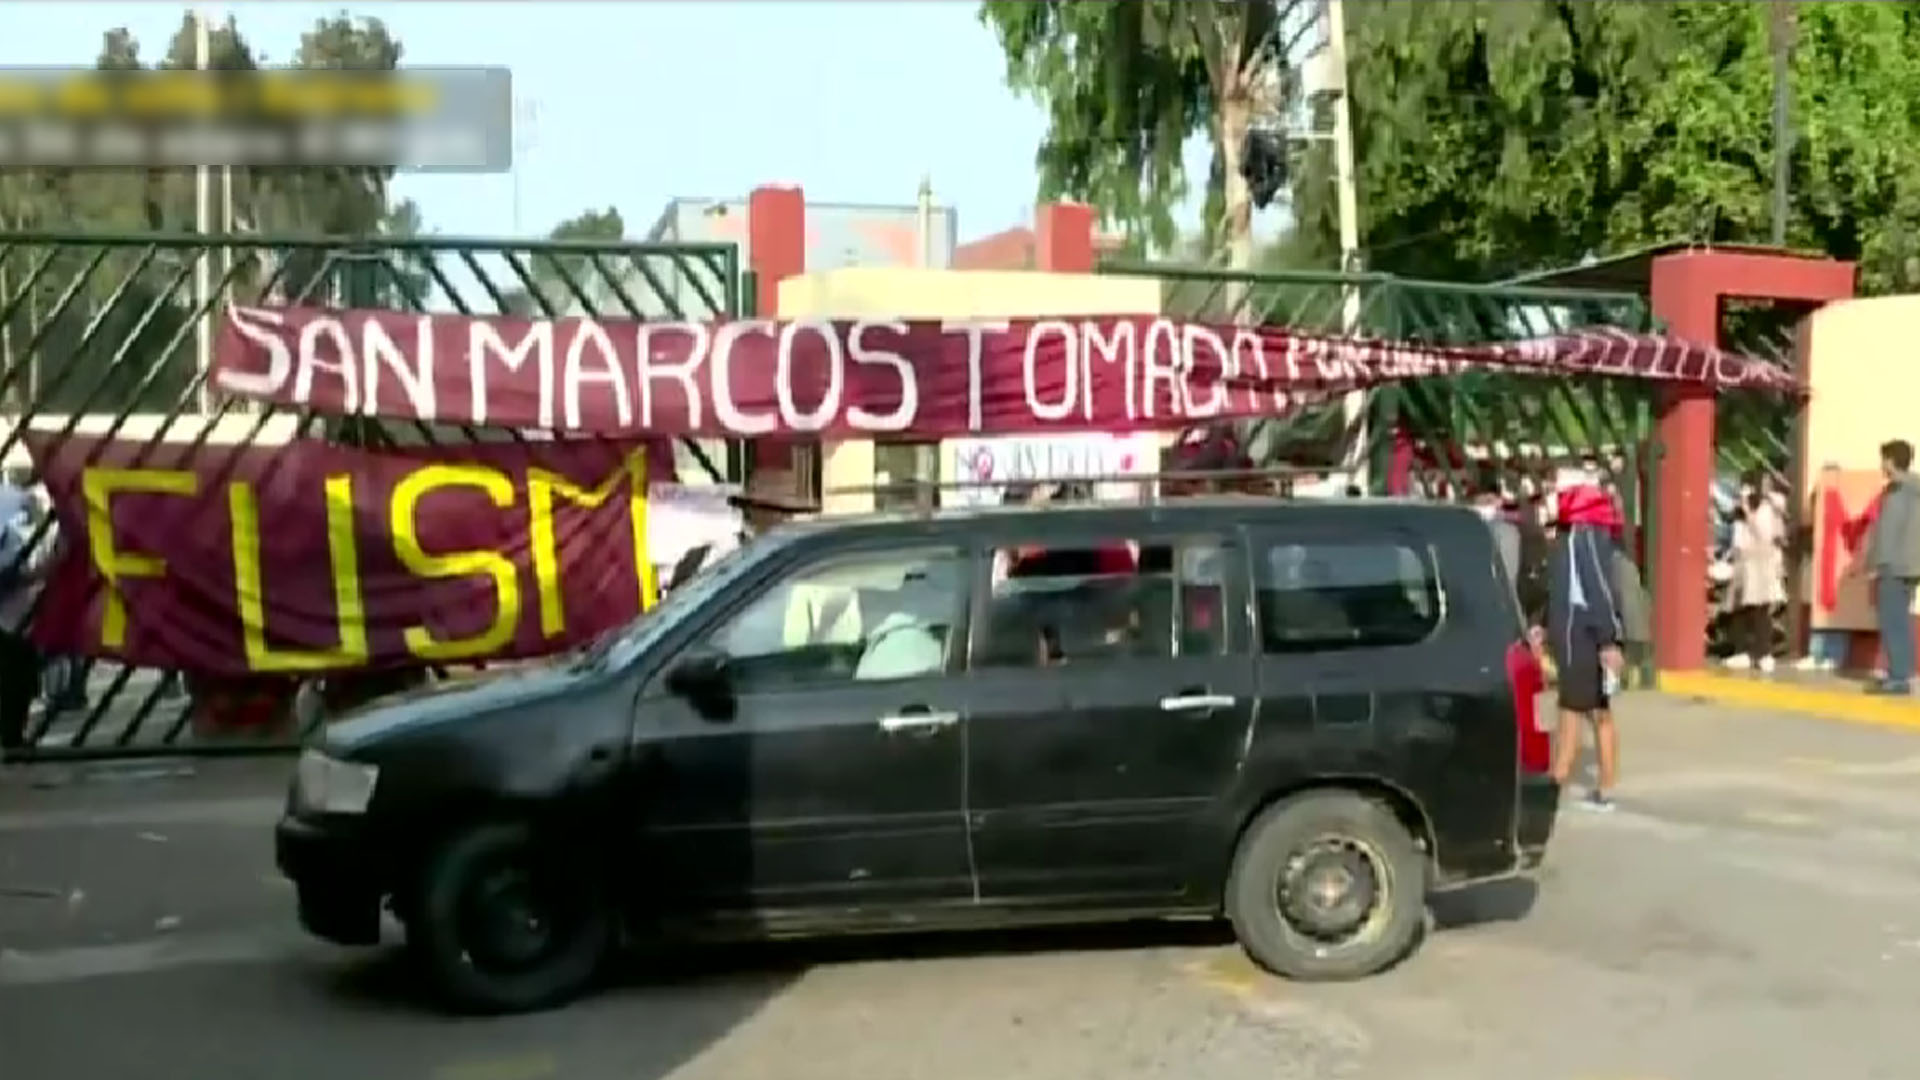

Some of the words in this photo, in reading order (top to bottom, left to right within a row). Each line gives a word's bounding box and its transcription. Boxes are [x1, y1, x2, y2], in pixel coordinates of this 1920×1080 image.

[217, 302, 436, 420] SAN
[468, 314, 918, 432] MARCOS
[941, 318, 1268, 431] TOMADA
[83, 445, 660, 671] FUSM
